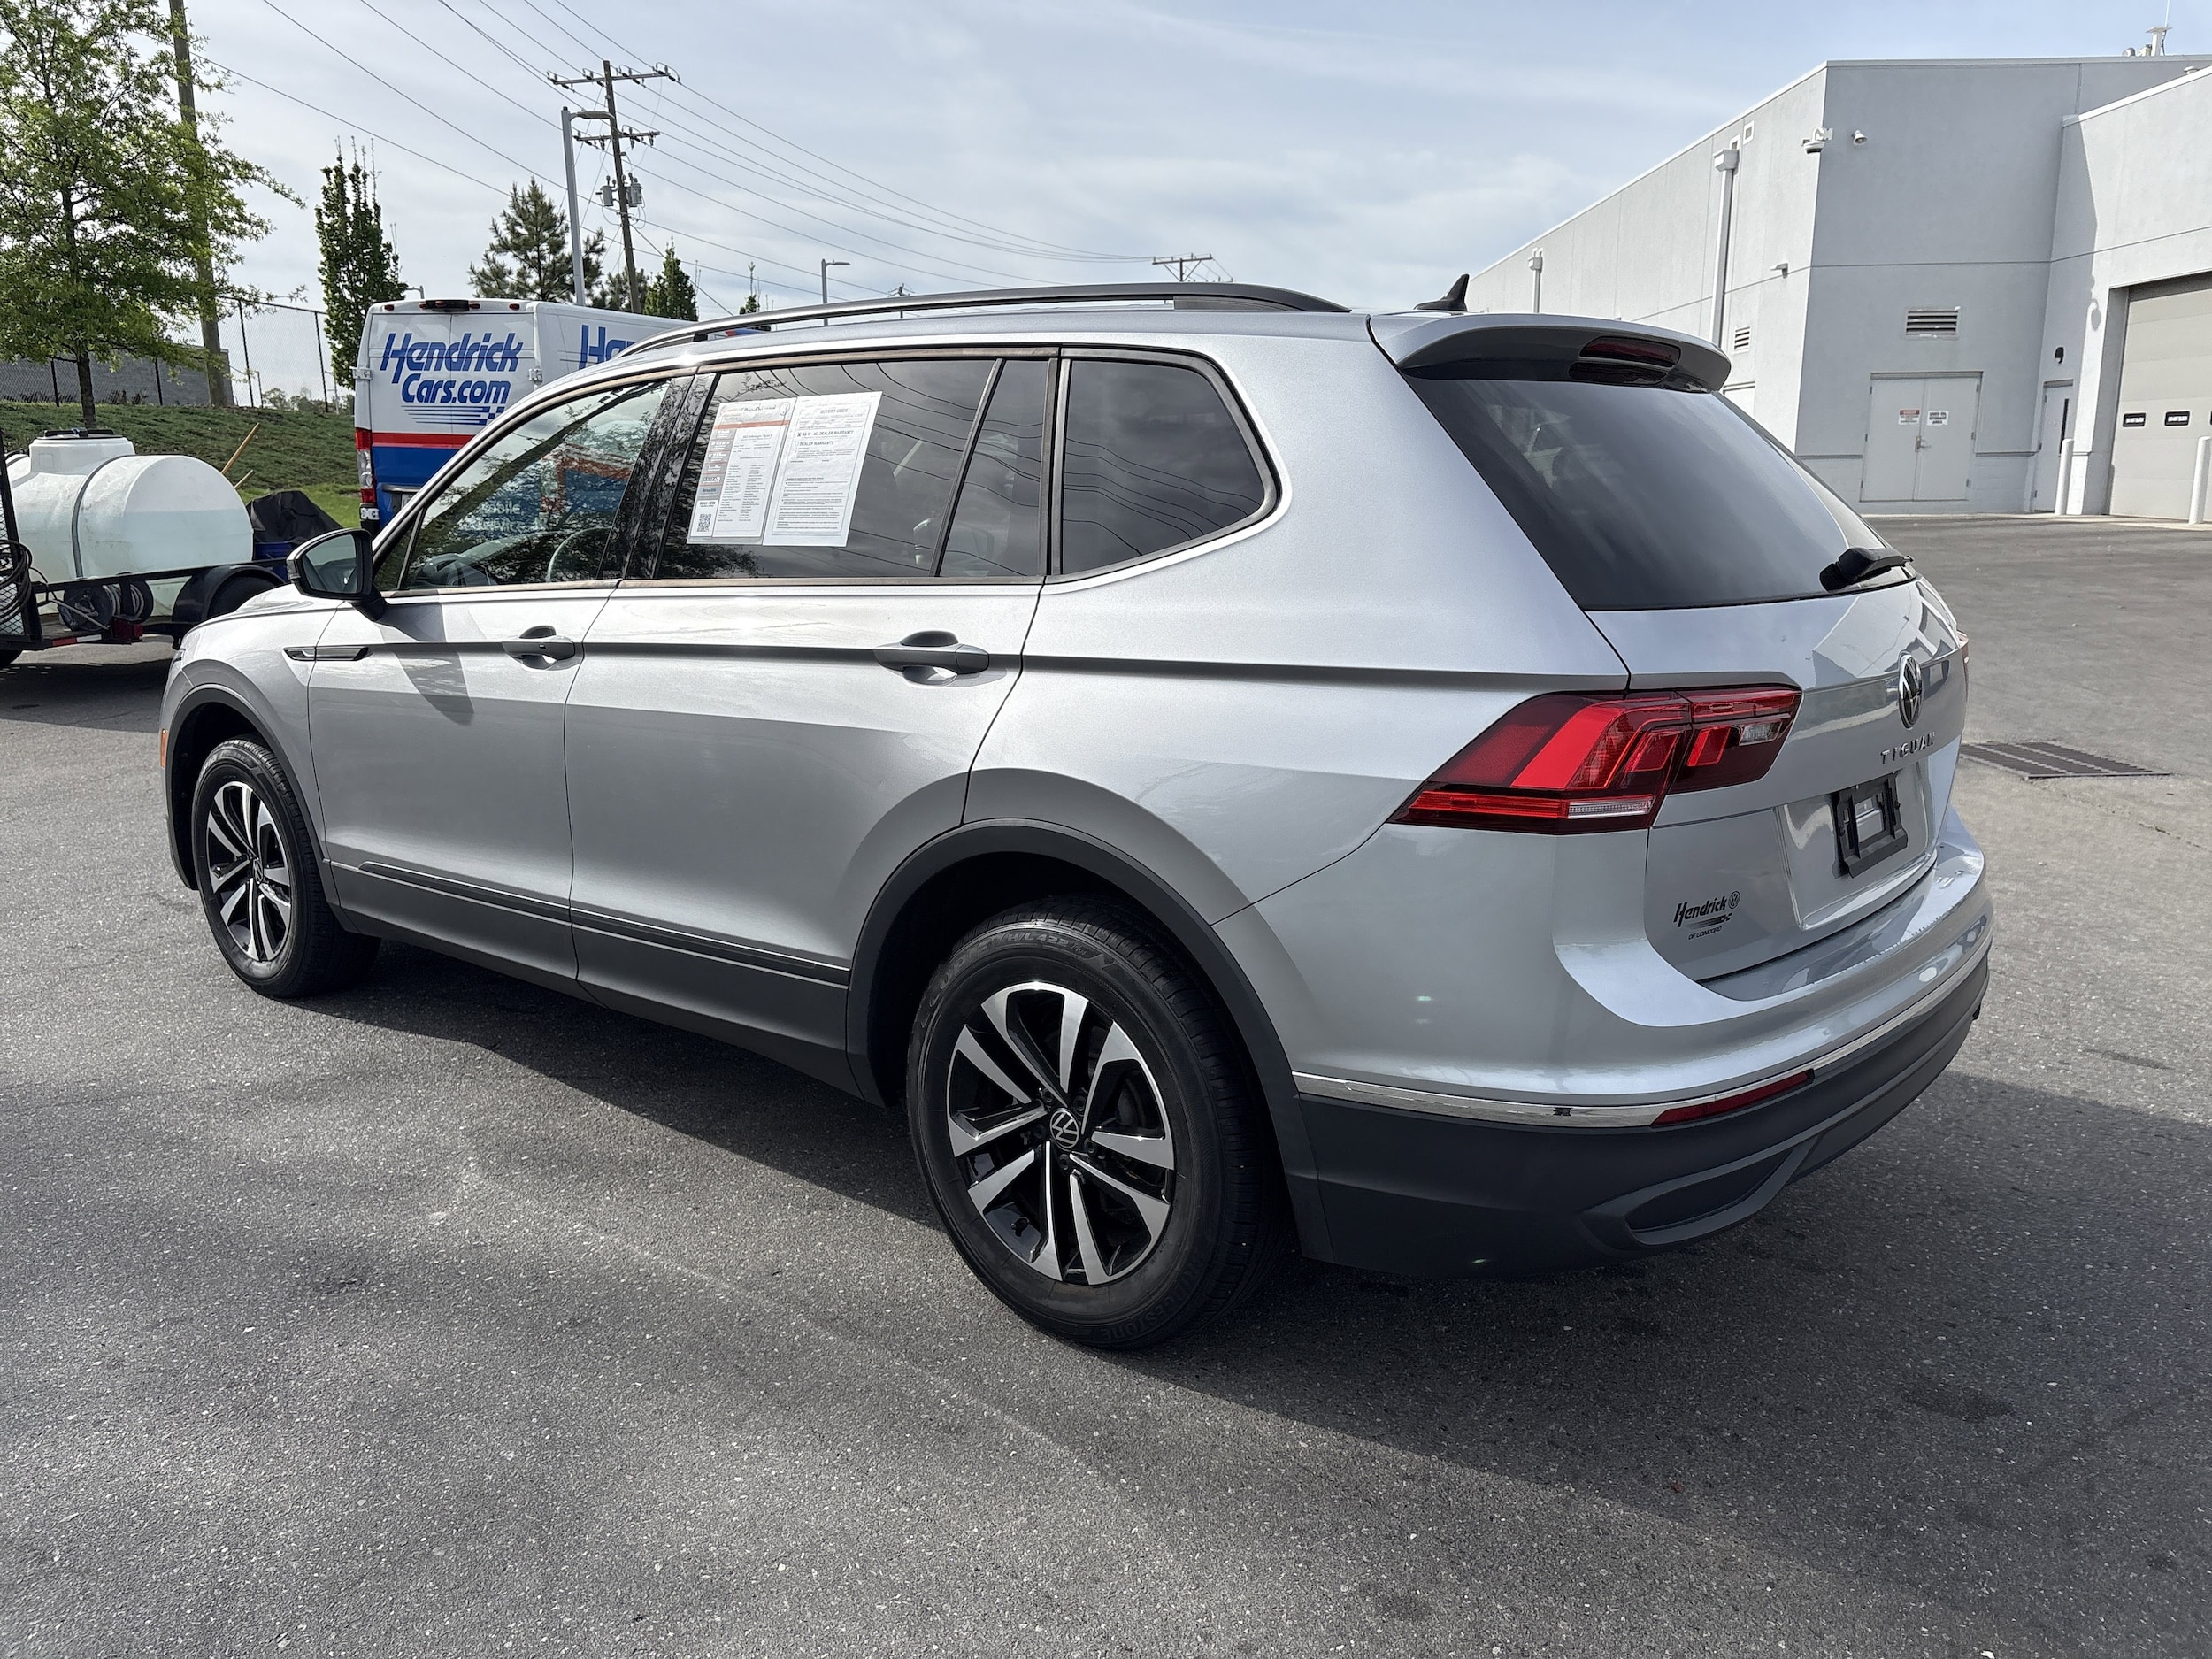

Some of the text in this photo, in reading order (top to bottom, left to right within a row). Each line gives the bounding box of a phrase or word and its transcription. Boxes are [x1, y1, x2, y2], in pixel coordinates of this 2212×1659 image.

[380, 333, 524, 384] Hendrick
[401, 373, 511, 404] Cars.com
[1880, 731, 1935, 765] TIGUAN
[1673, 895, 1727, 928] Hendrick
[1036, 933, 1069, 948] 422
